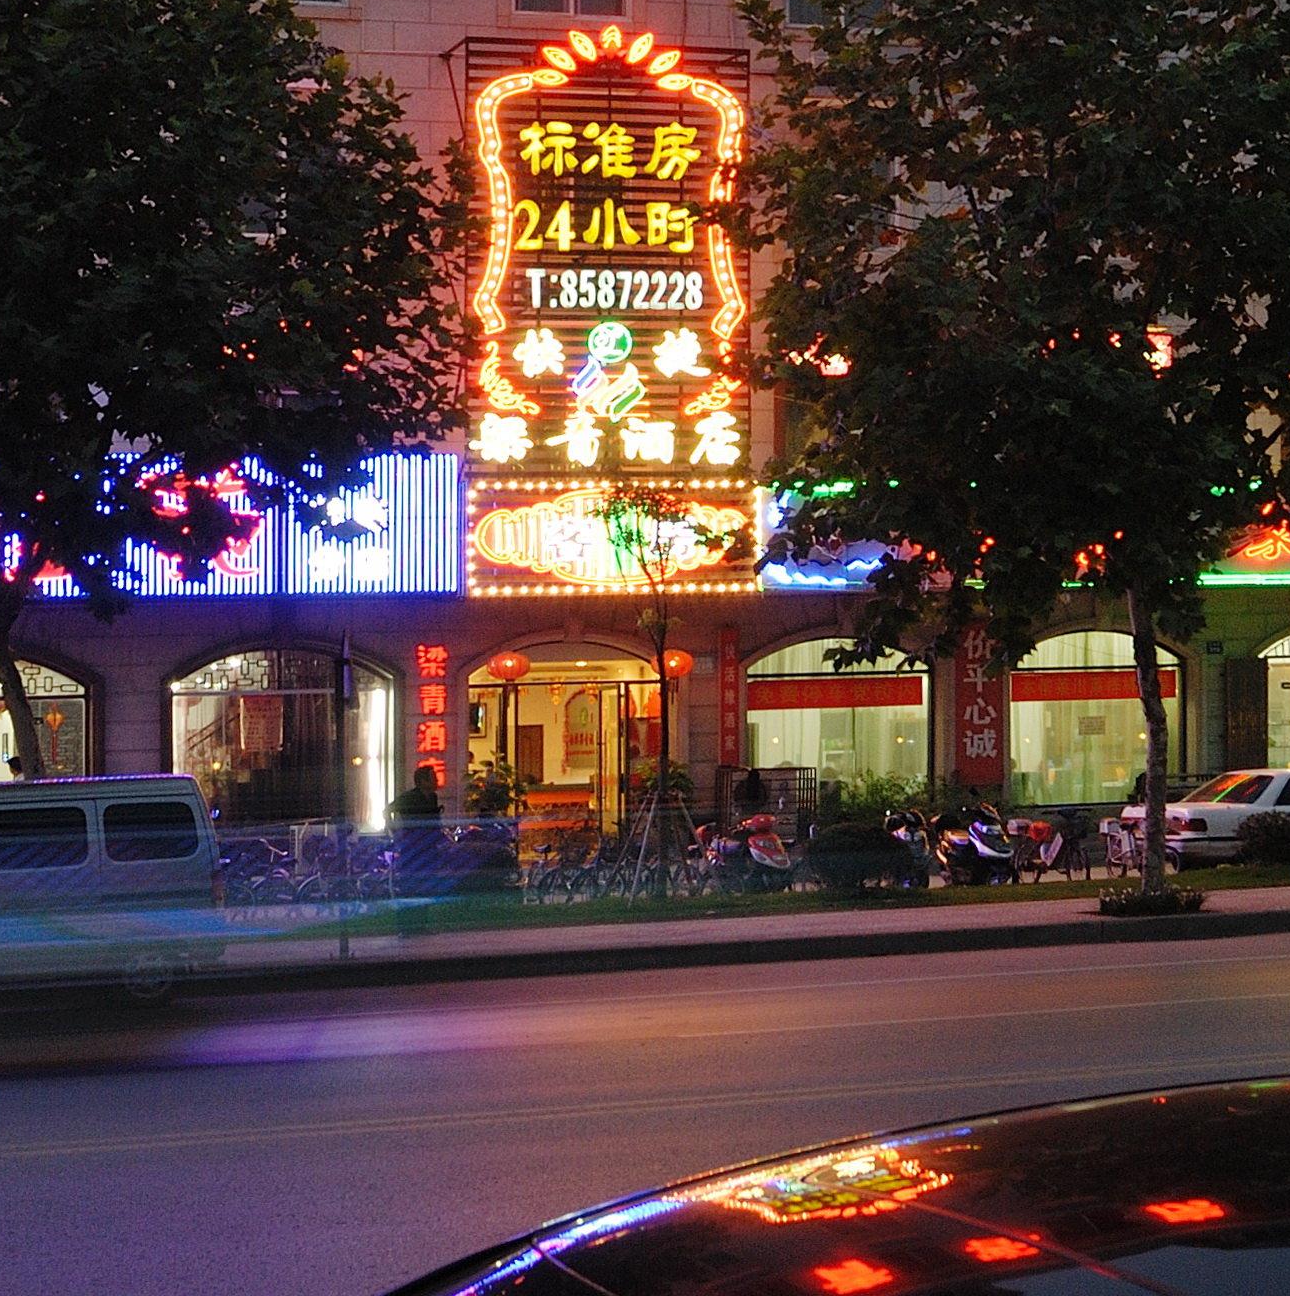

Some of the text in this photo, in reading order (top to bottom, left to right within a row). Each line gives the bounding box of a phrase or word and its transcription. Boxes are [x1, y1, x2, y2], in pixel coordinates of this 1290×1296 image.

[518, 120, 702, 181] 标准房
[512, 197, 700, 254] 24小时
[525, 267, 704, 311] T:85872228
[468, 410, 742, 467] 梁青酒店
